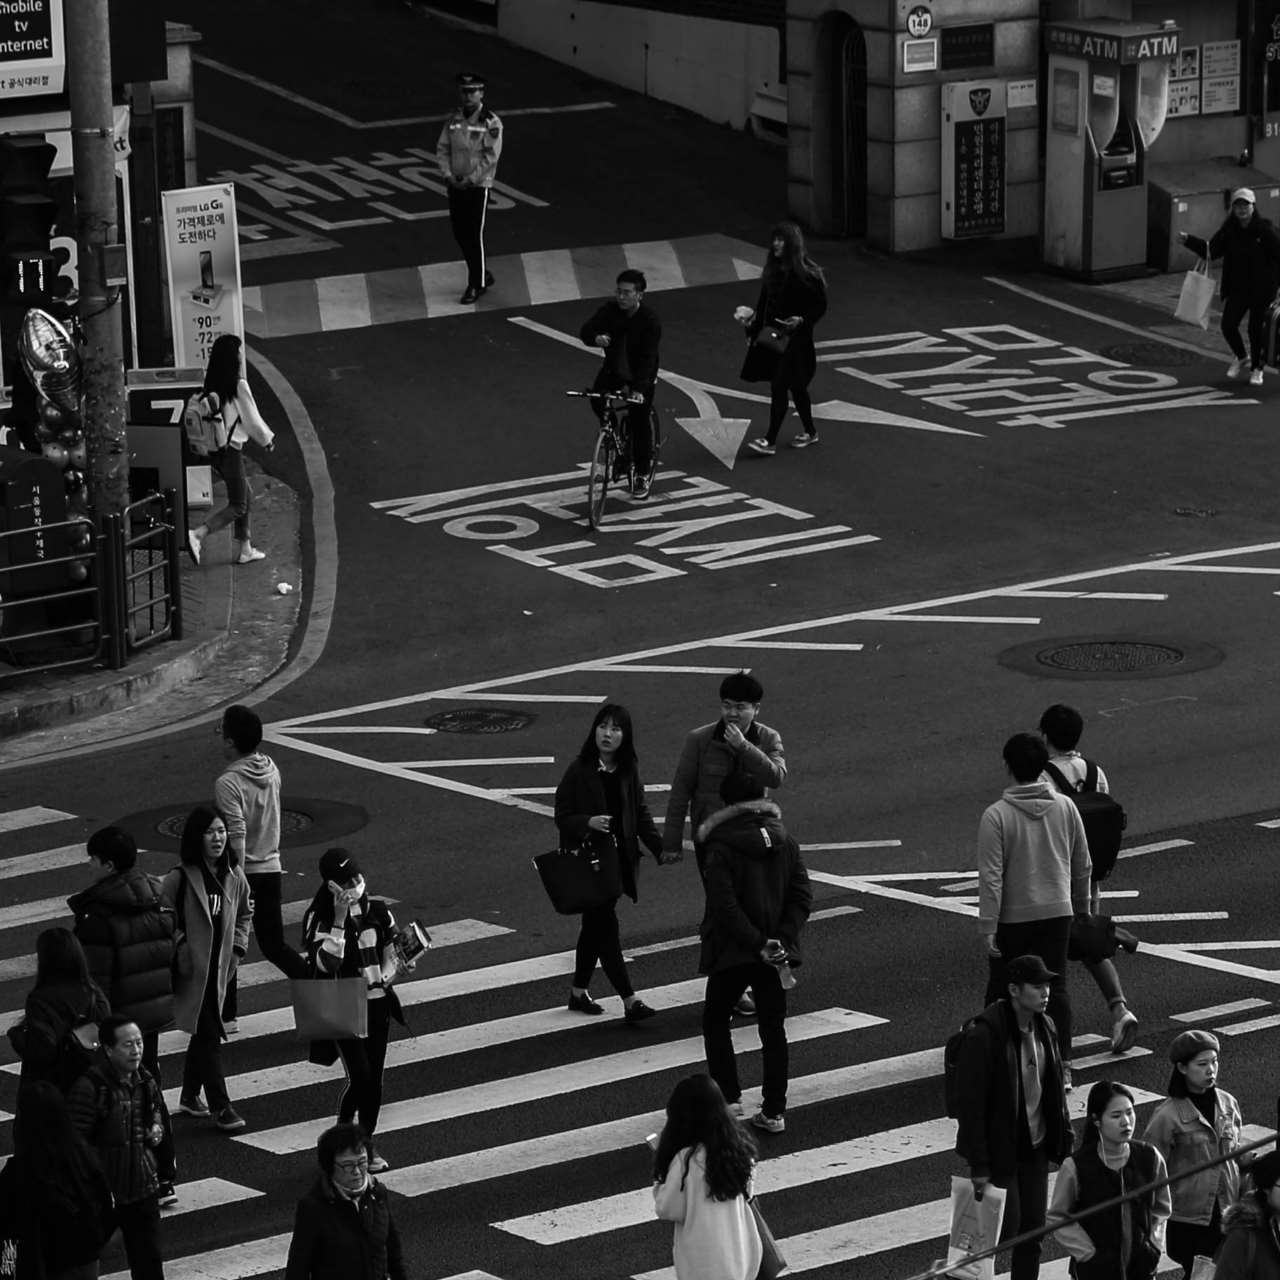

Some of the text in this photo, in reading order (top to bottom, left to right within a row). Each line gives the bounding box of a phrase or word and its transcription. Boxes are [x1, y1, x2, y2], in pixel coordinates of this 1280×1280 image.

[14, 20, 29, 33] tv
[911, 18, 929, 29] 148
[1082, 36, 1119, 60] ATM
[1137, 35, 1178, 59] ATM
[8, 75, 50, 88] 공식대리점
[199, 203, 210, 212] LG
[176, 212, 226, 231] 가격제로에
[177, 228, 217, 244] 도전하다
